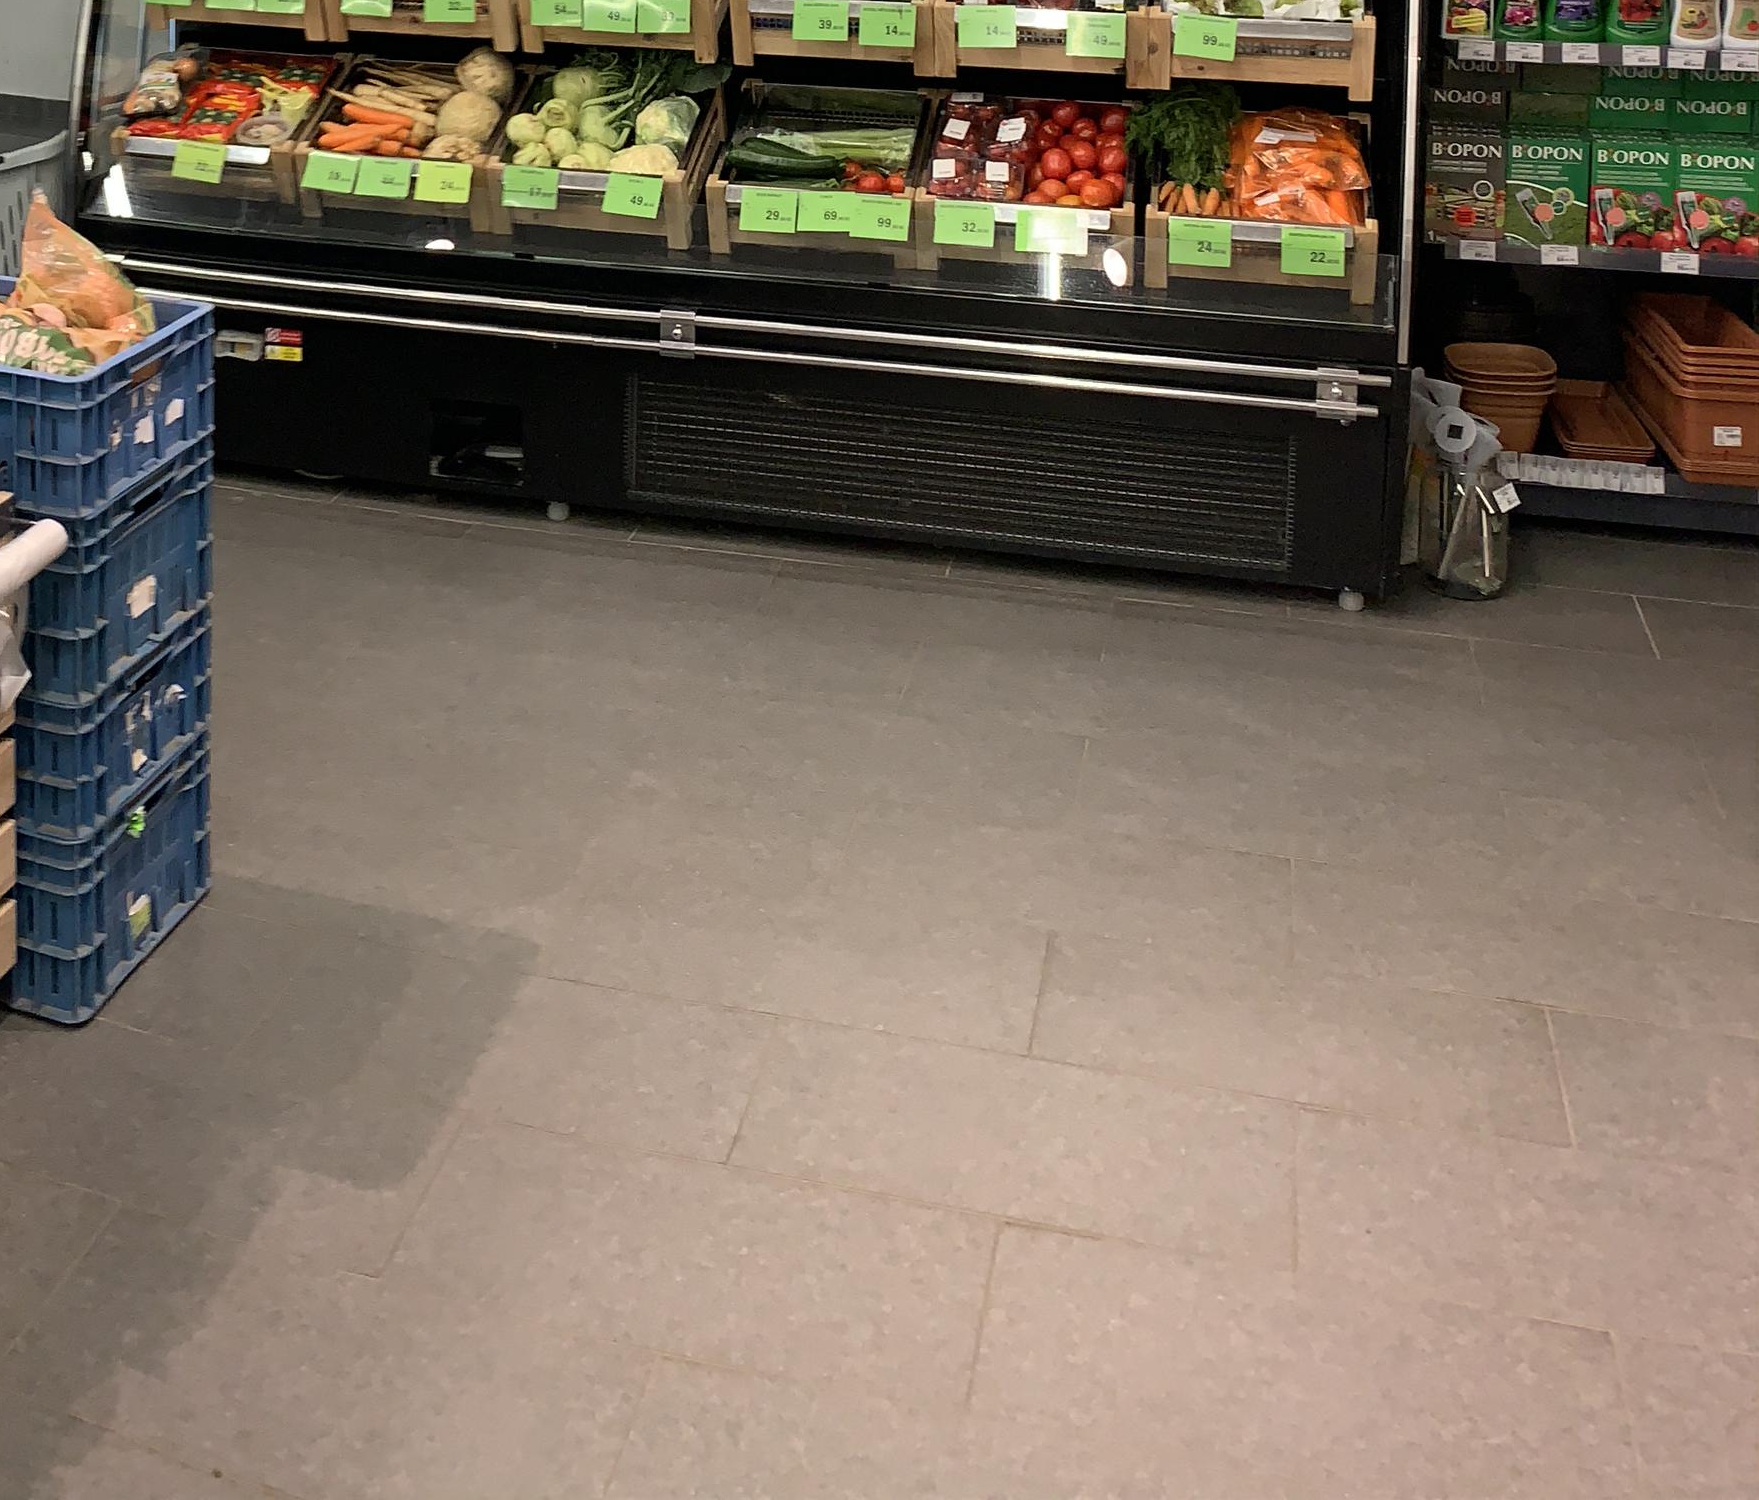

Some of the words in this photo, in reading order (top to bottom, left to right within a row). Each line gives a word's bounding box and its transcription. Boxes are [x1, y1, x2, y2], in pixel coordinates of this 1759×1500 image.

[1434, 89, 1502, 105] BOPON
[1595, 96, 1665, 112] BOPON
[1676, 100, 1748, 115] BOPON
[1431, 141, 1503, 159] BOPON
[1511, 144, 1583, 161] BOPON
[1596, 149, 1670, 166] BOPON
[1680, 153, 1756, 171] BOPON
